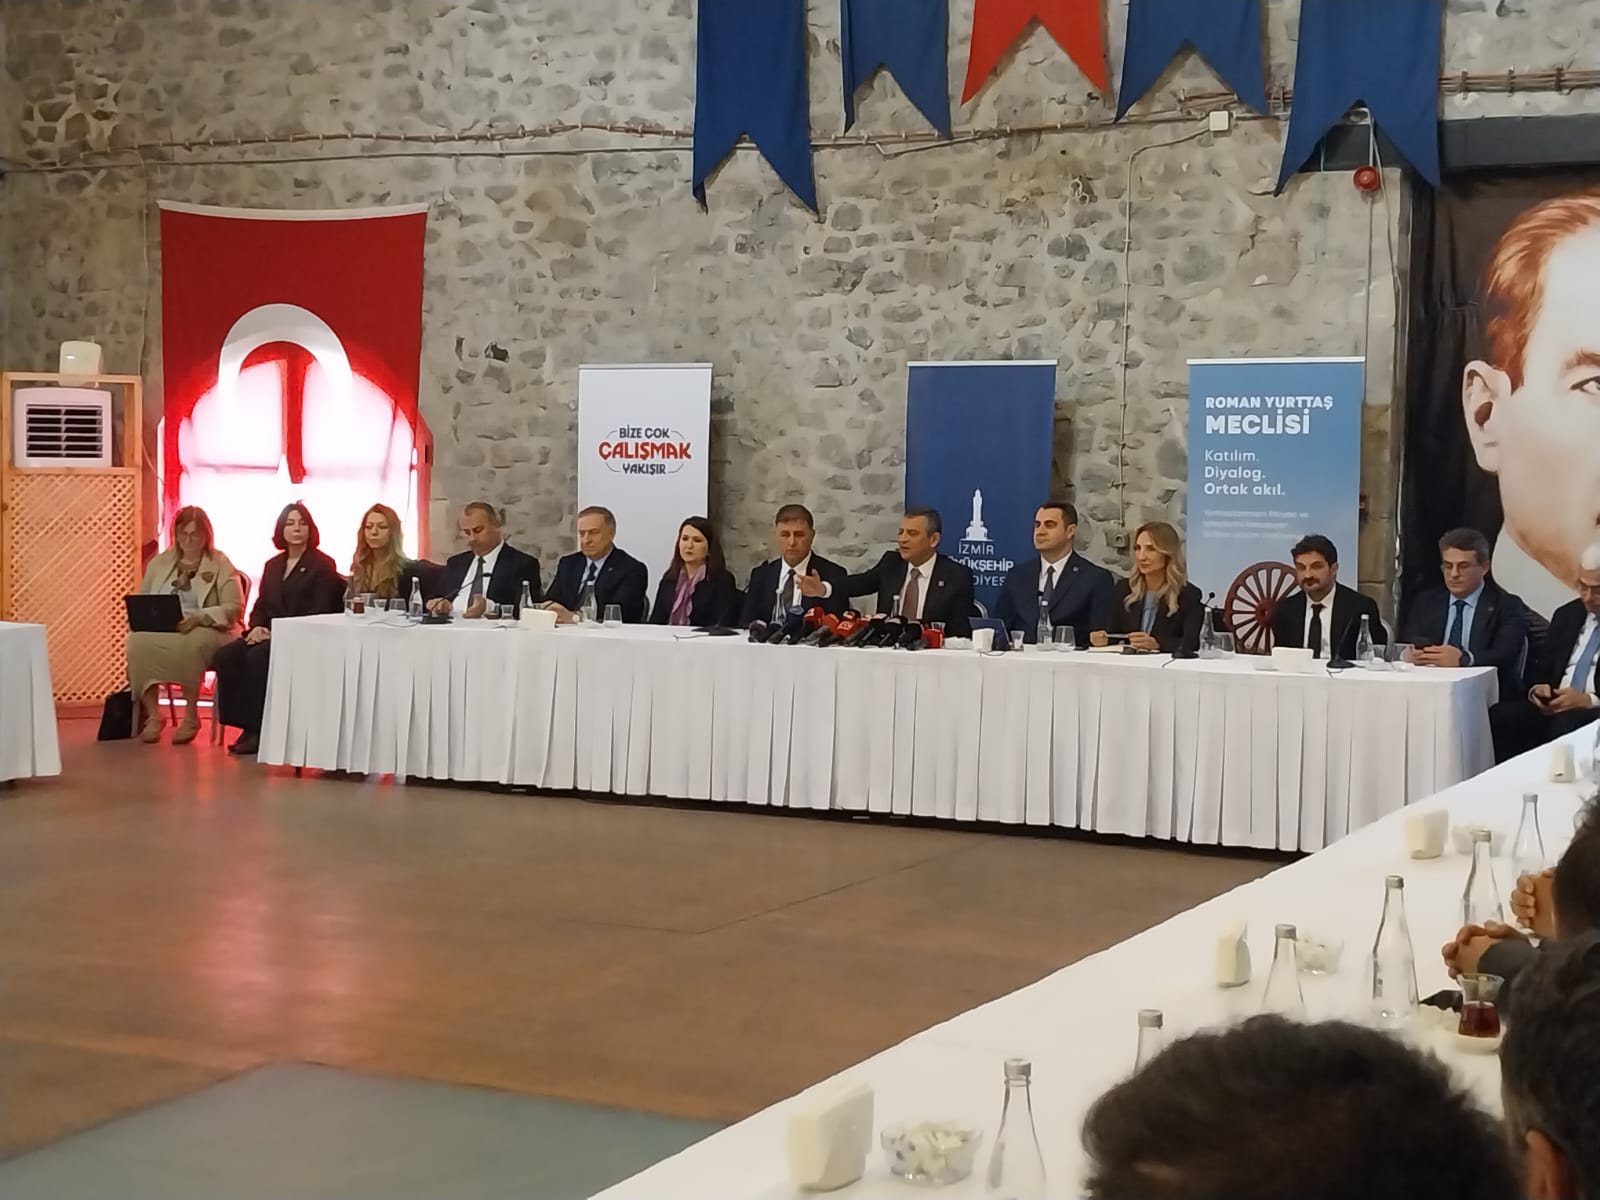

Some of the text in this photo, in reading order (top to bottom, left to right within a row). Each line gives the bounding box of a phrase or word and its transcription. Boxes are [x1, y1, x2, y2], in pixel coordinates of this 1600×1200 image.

[1205, 395, 1333, 411] ROMAN YURTTAŞ
[1206, 408, 1310, 434] MECLİSİ
[619, 424, 669, 439] BİZE ÇOK
[599, 441, 691, 460] ÇALIŞMAK
[1204, 449, 1260, 461] Katılım.
[622, 463, 666, 475] YAKIŞIR
[1204, 466, 1267, 481] Diyalog.
[1204, 483, 1286, 496] Ortak akıl.
[959, 541, 994, 555] İZMİR
